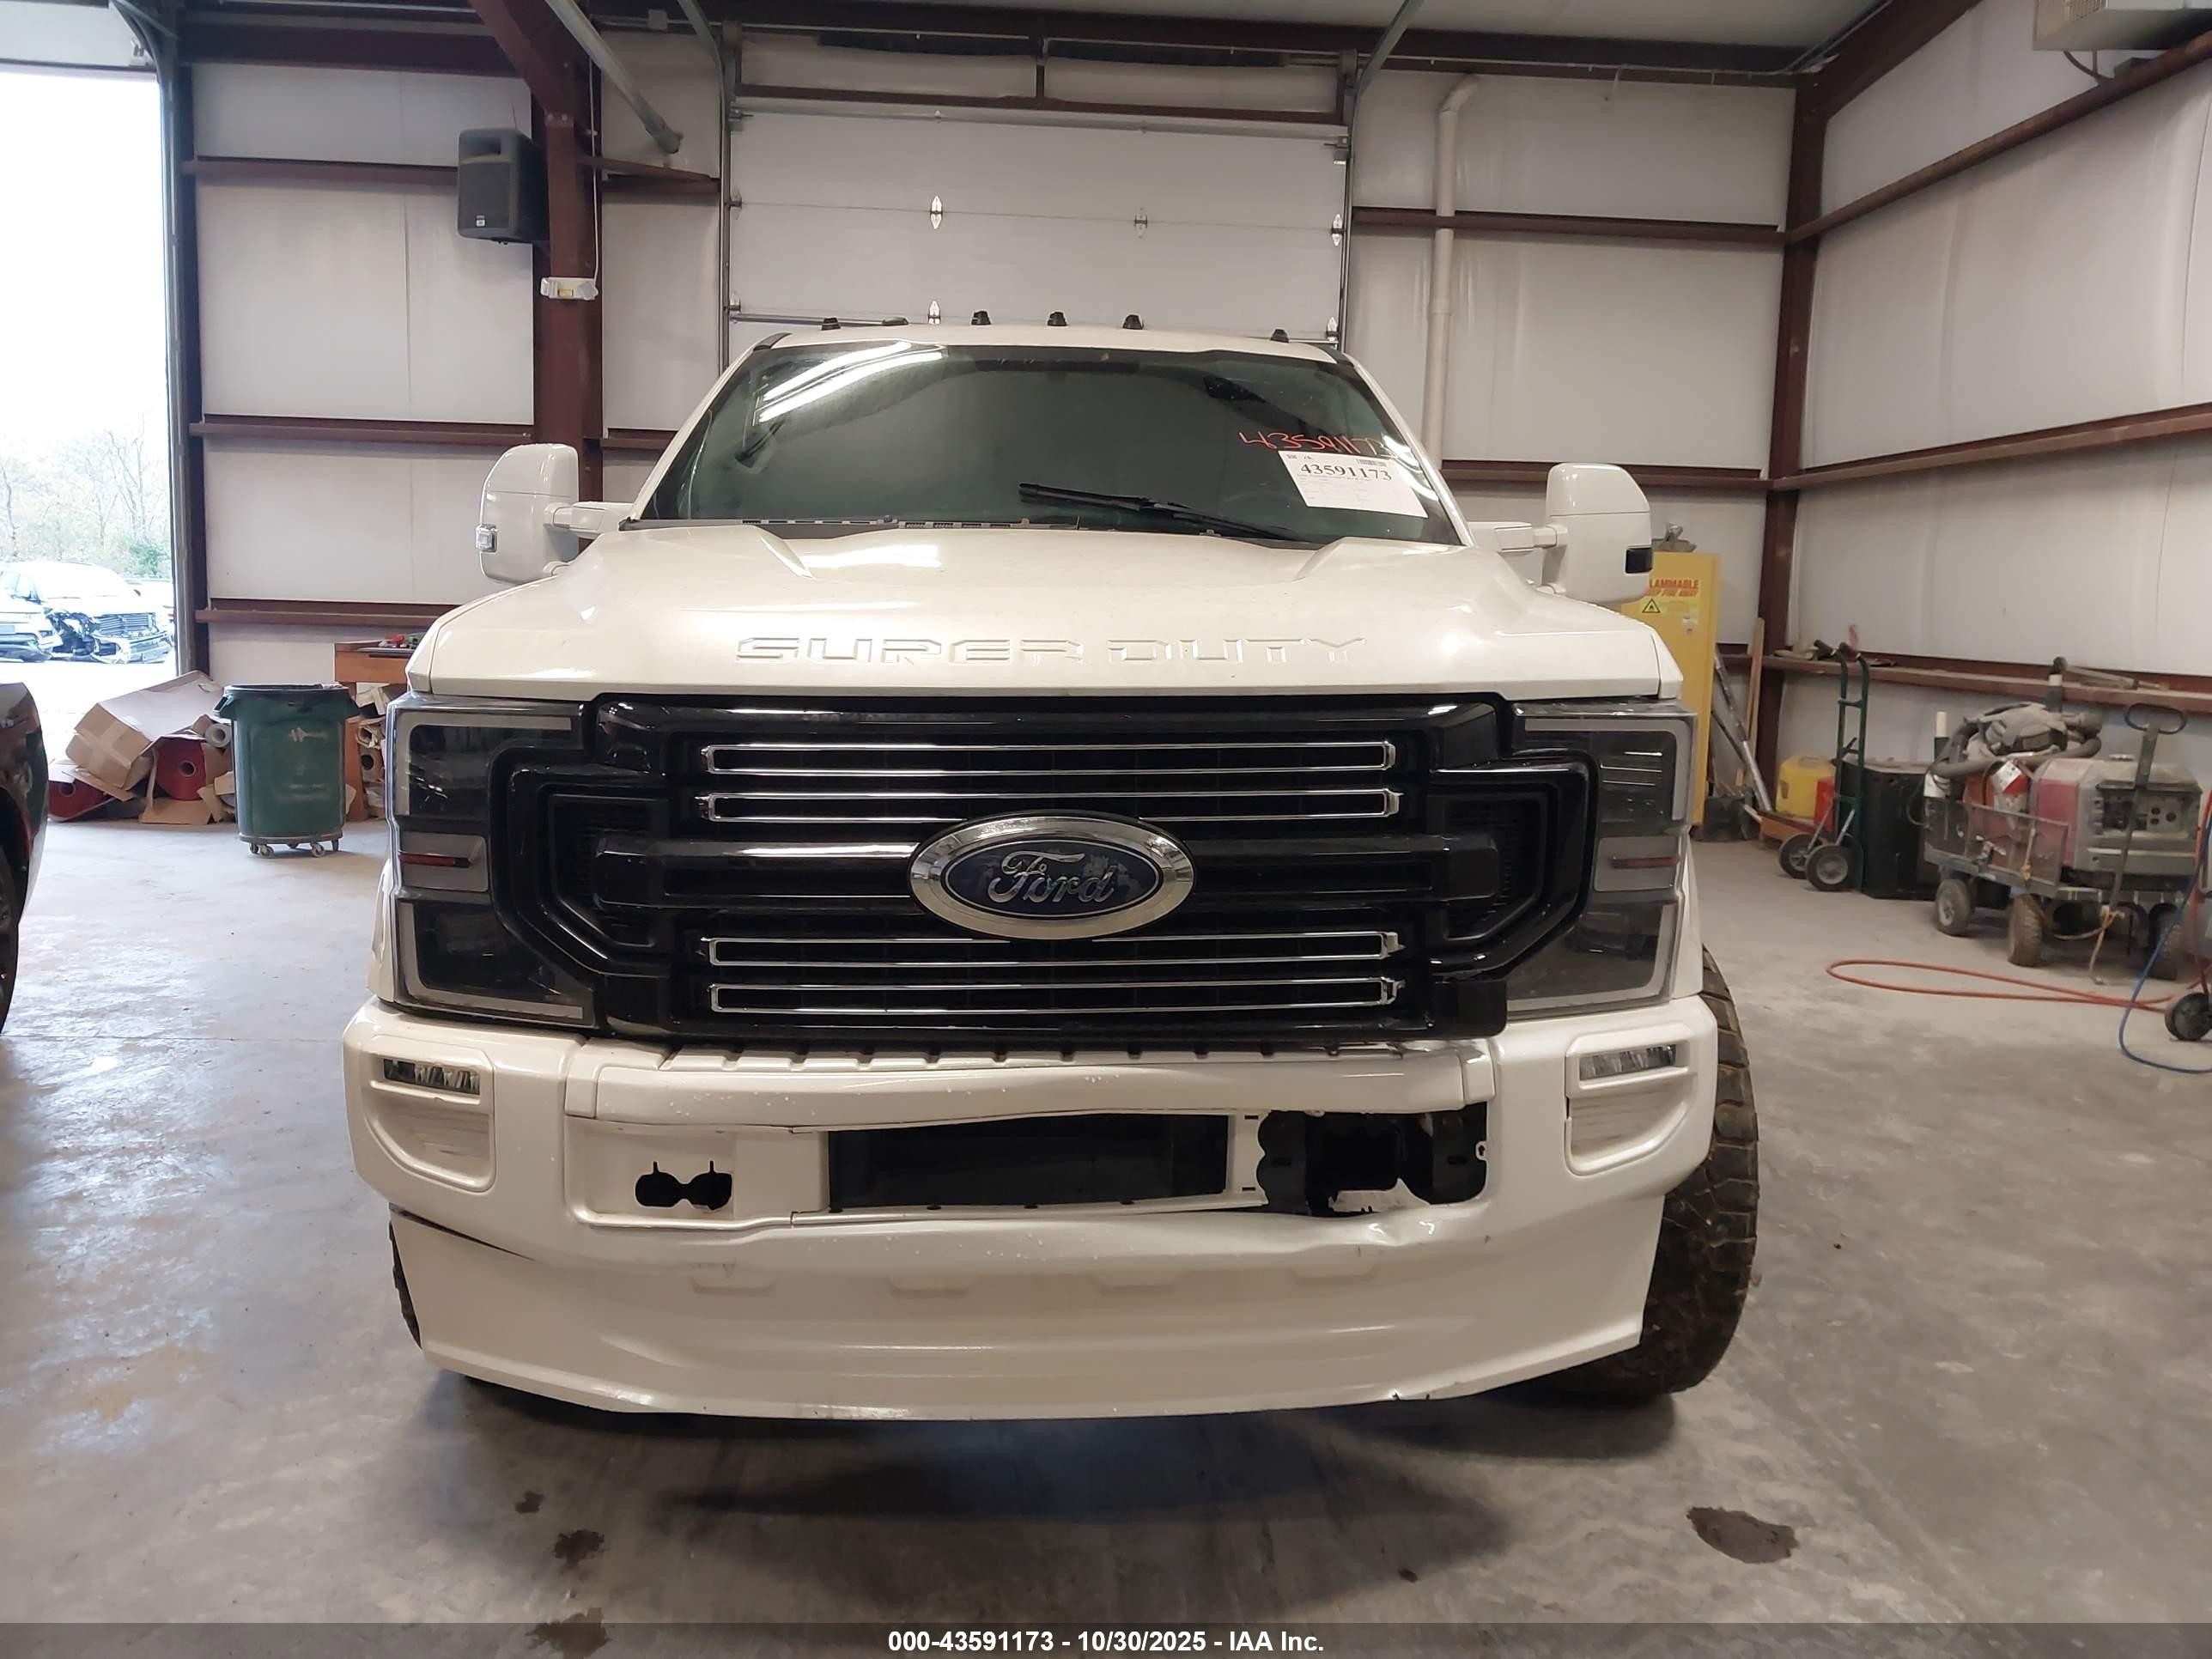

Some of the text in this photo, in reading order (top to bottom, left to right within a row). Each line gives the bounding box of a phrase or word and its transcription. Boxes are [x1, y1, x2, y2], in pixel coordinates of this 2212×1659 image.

[1300, 463, 1393, 482] 43591173
[1648, 579, 1699, 588] LAMMABLE
[735, 636, 1366, 665] SUPER DUTY
[987, 850, 1119, 902] Ford
